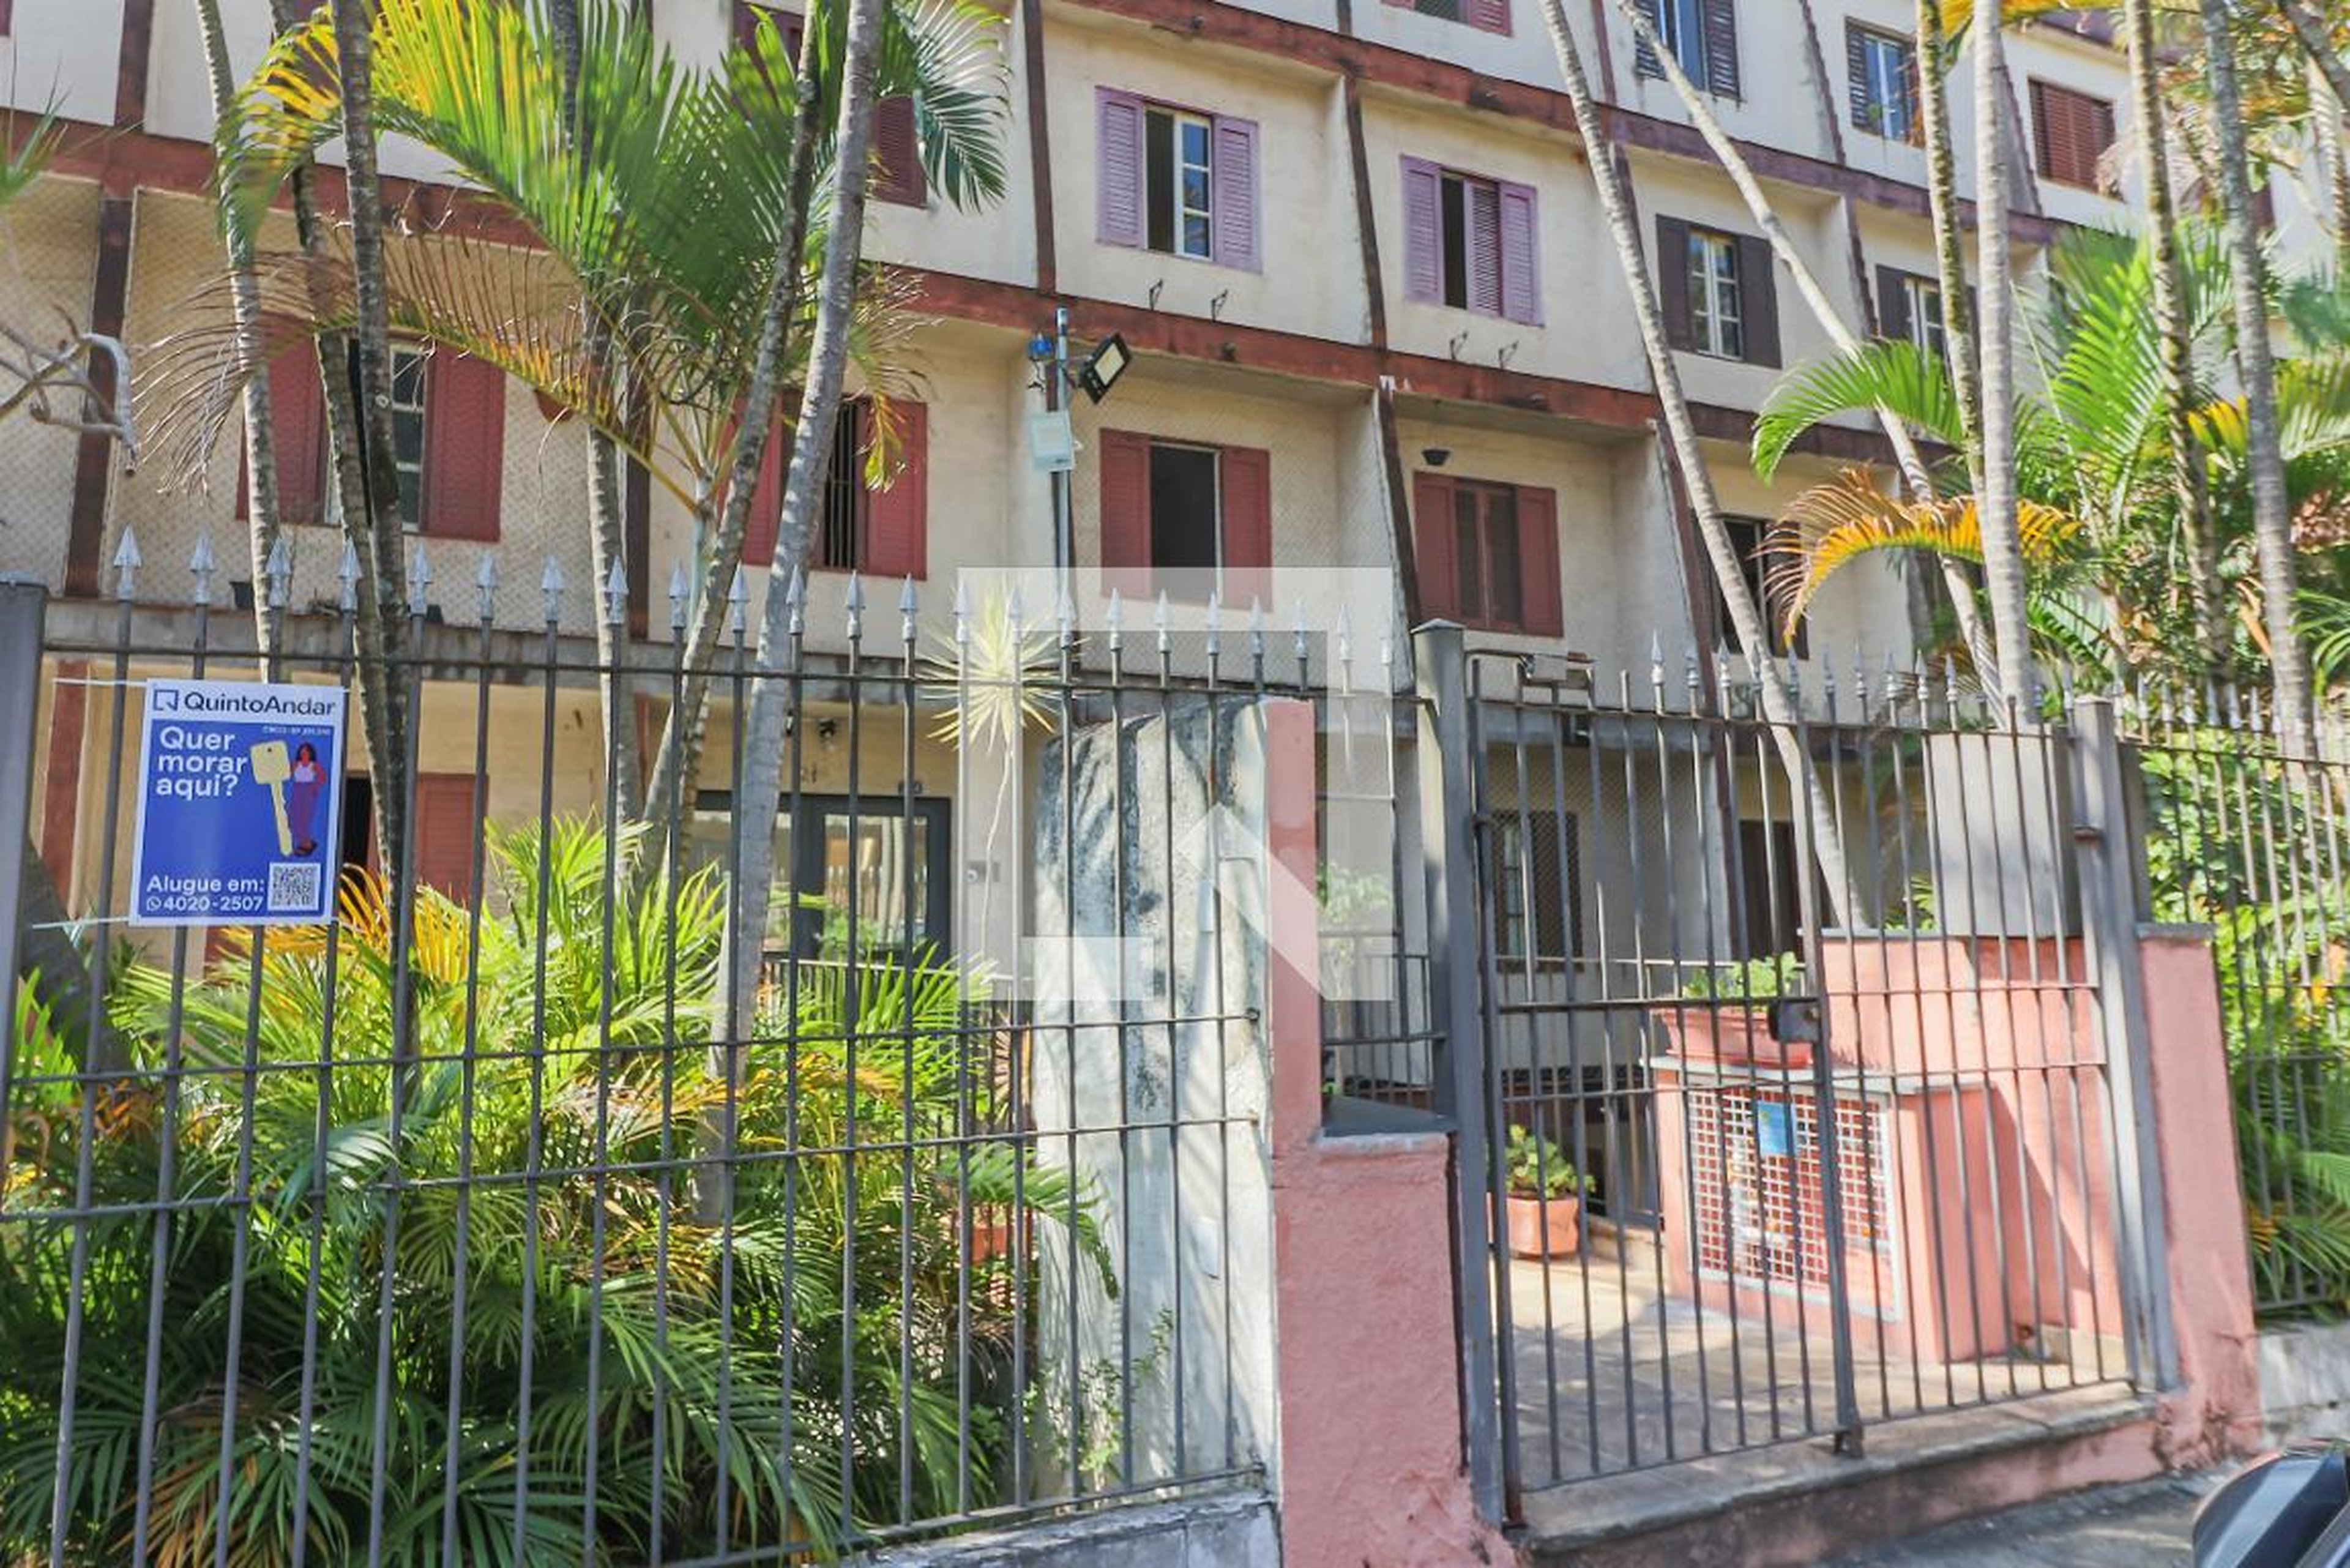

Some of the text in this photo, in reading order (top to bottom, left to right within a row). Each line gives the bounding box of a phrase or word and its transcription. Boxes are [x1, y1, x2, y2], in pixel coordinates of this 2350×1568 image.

[184, 692, 336, 715] QuintoAndar
[160, 726, 236, 750] Quer
[158, 754, 248, 774] morar
[156, 774, 239, 801] aqui?
[146, 875, 265, 896] Alugue em:
[163, 896, 264, 911] 4020-2507
